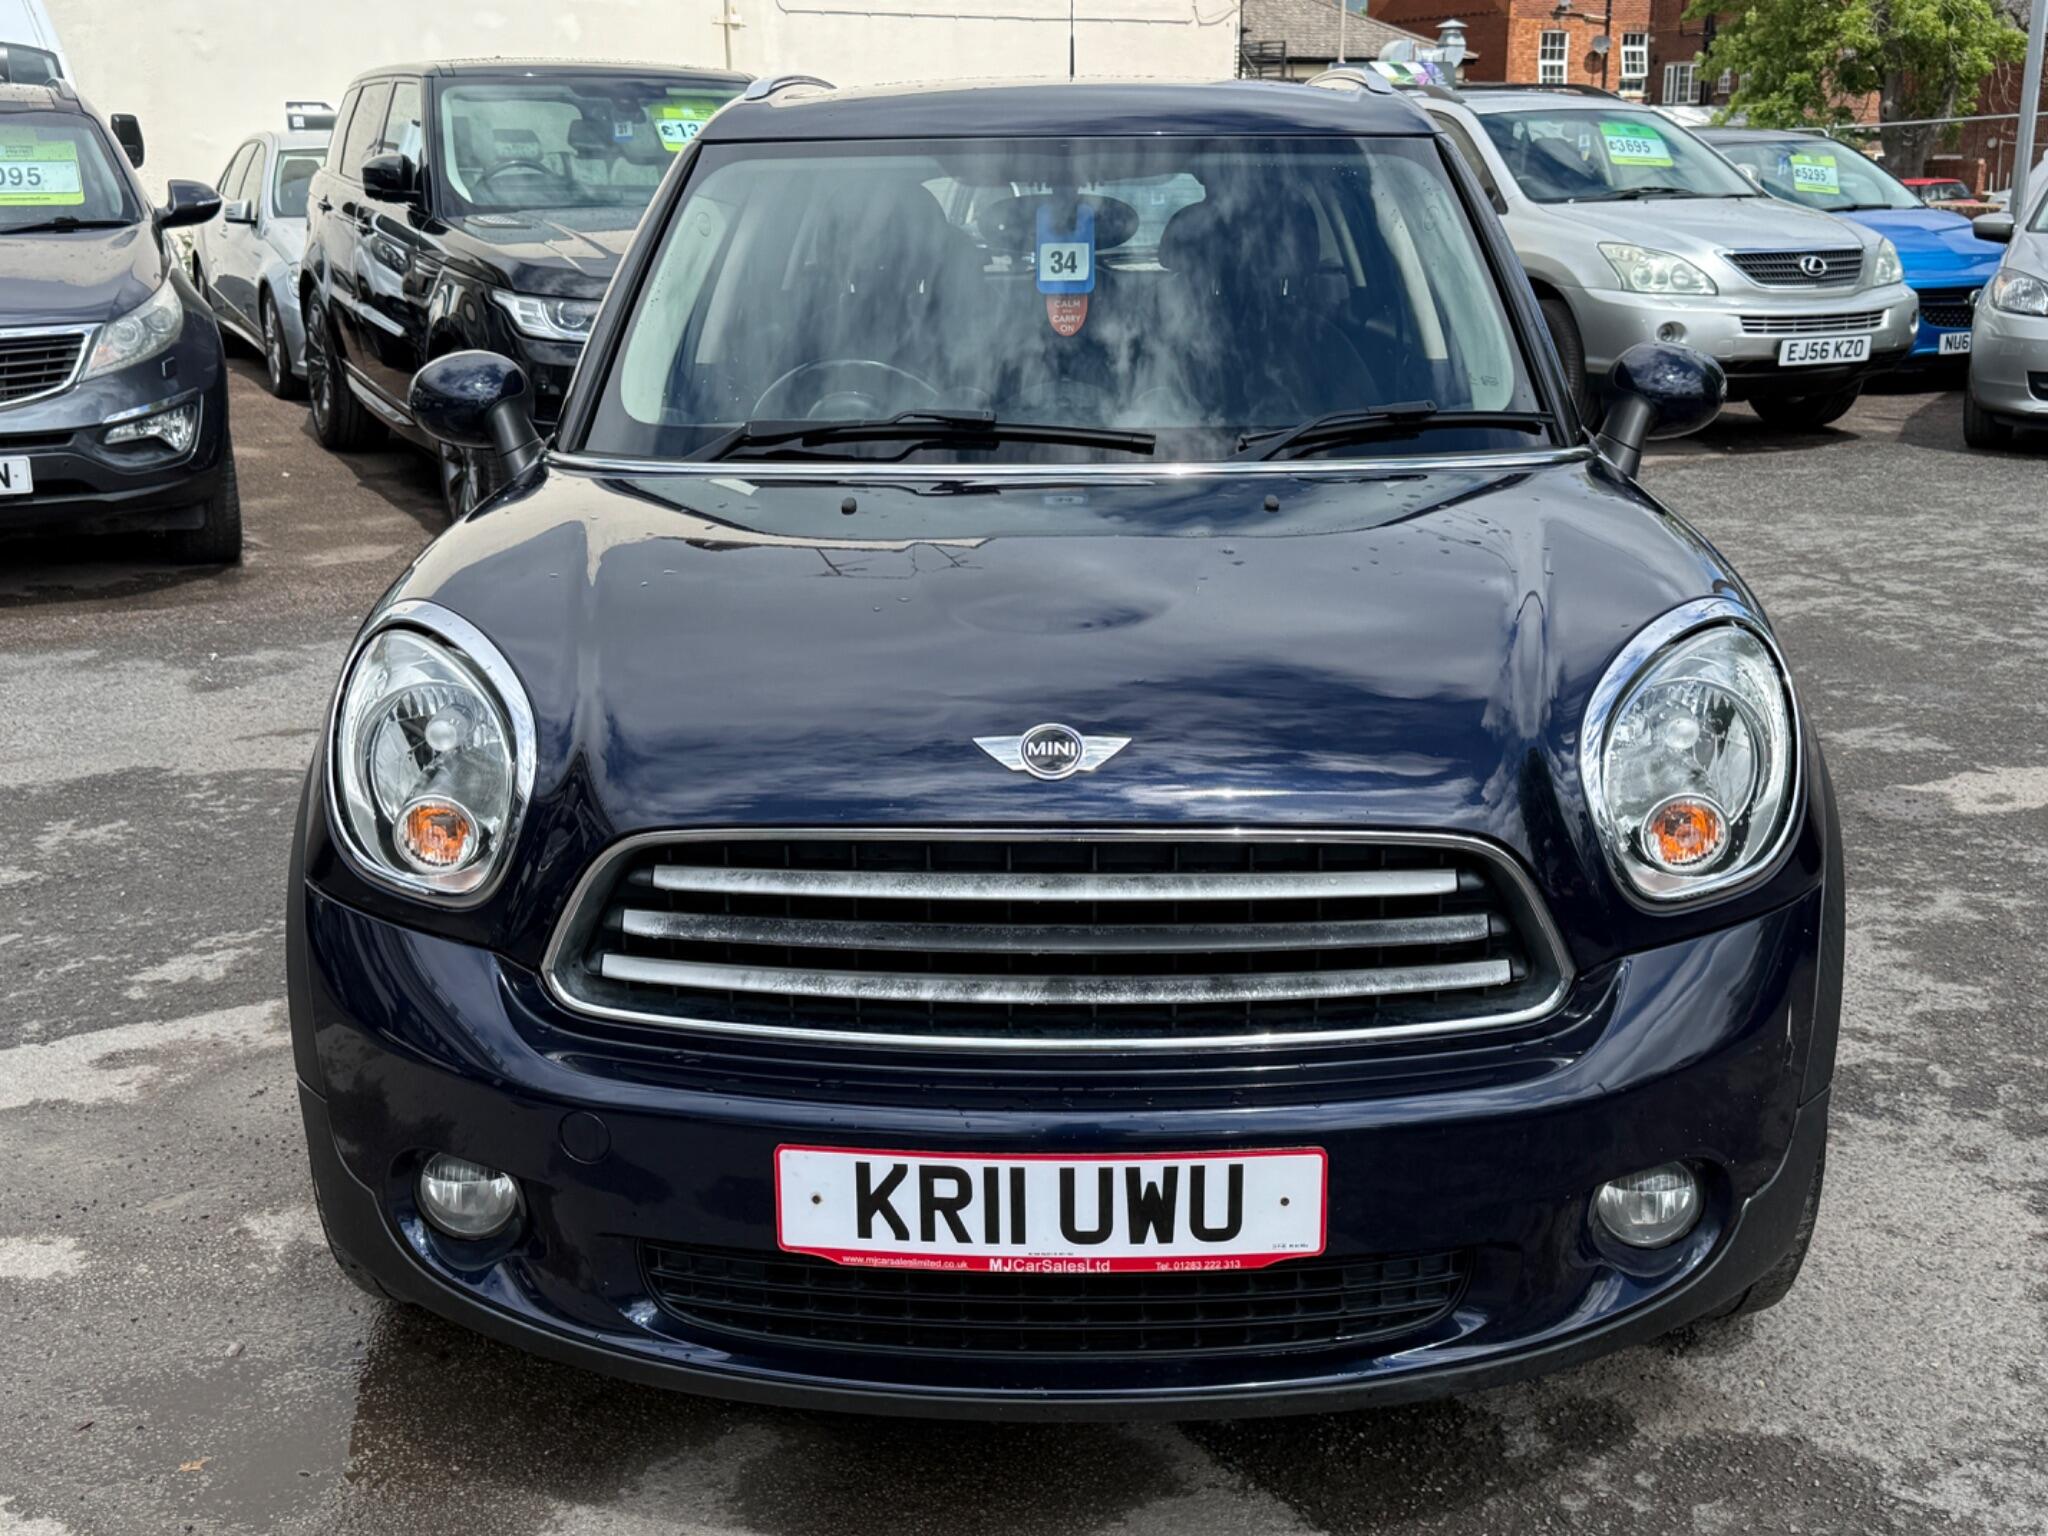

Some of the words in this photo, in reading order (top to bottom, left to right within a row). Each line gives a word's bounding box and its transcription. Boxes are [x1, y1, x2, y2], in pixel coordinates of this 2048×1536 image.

[1609, 139, 1651, 153] £3695
[1795, 167, 1827, 181] £5295
[1050, 251, 1077, 273] 34
[1055, 300, 1081, 308] CALM
[1053, 314, 1081, 323] CARRY
[1059, 324, 1075, 333] ON
[1945, 334, 1969, 350] NU6
[1787, 342, 1829, 362] EJ56
[1833, 339, 1865, 360] KZO
[1028, 741, 1076, 756] MINI
[855, 1161, 1026, 1245] KR11
[1059, 1163, 1244, 1245] UWU
[842, 1255, 968, 1269] www.mjcarsaleslimited.co.uk
[989, 1258, 1111, 1272] MJCarSalesLtd
[1173, 1260, 1201, 1271] 01283
[1204, 1260, 1221, 1270] 222
[1223, 1259, 1240, 1269] 313
